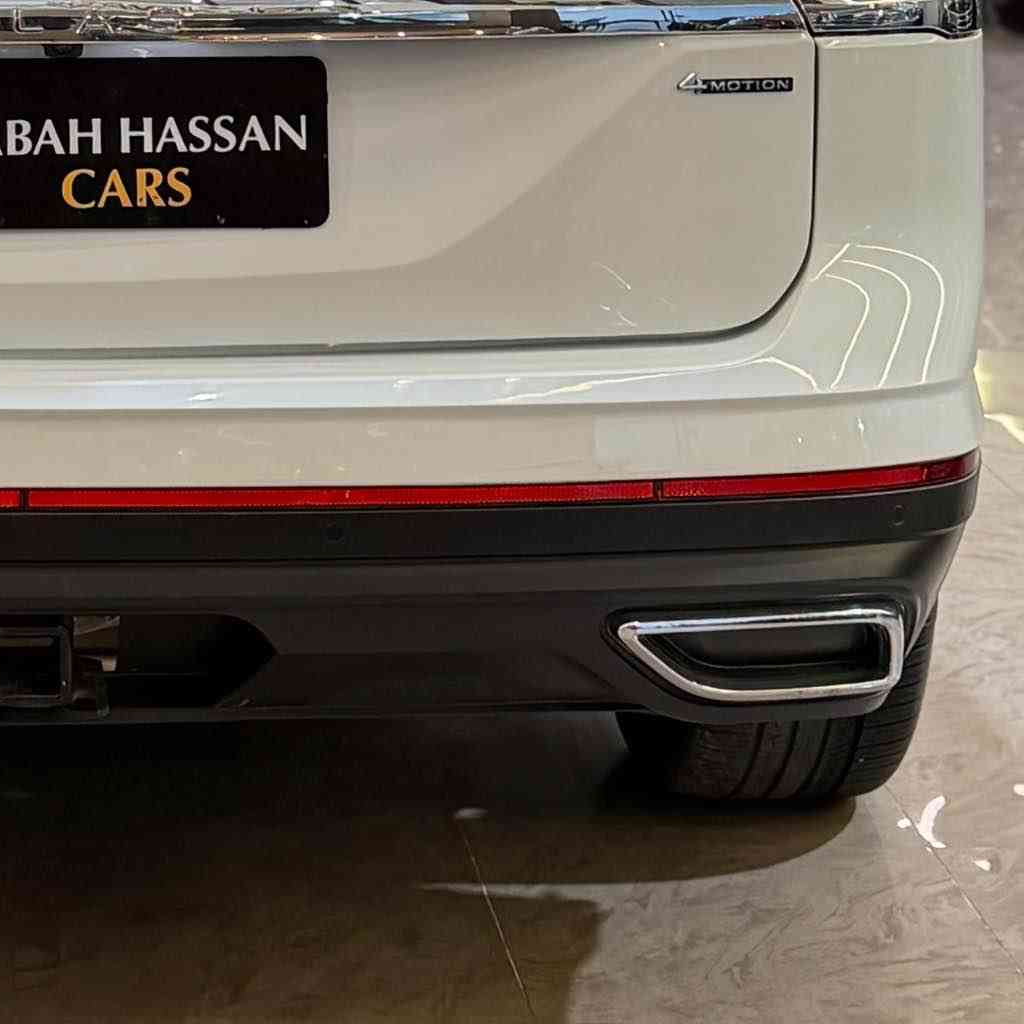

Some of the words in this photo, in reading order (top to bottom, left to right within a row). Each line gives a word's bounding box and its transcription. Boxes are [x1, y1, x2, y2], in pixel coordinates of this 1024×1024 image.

[677, 72, 789, 91] 4MOTION
[120, 114, 307, 153] HASSAN
[62, 167, 192, 209] CARS
